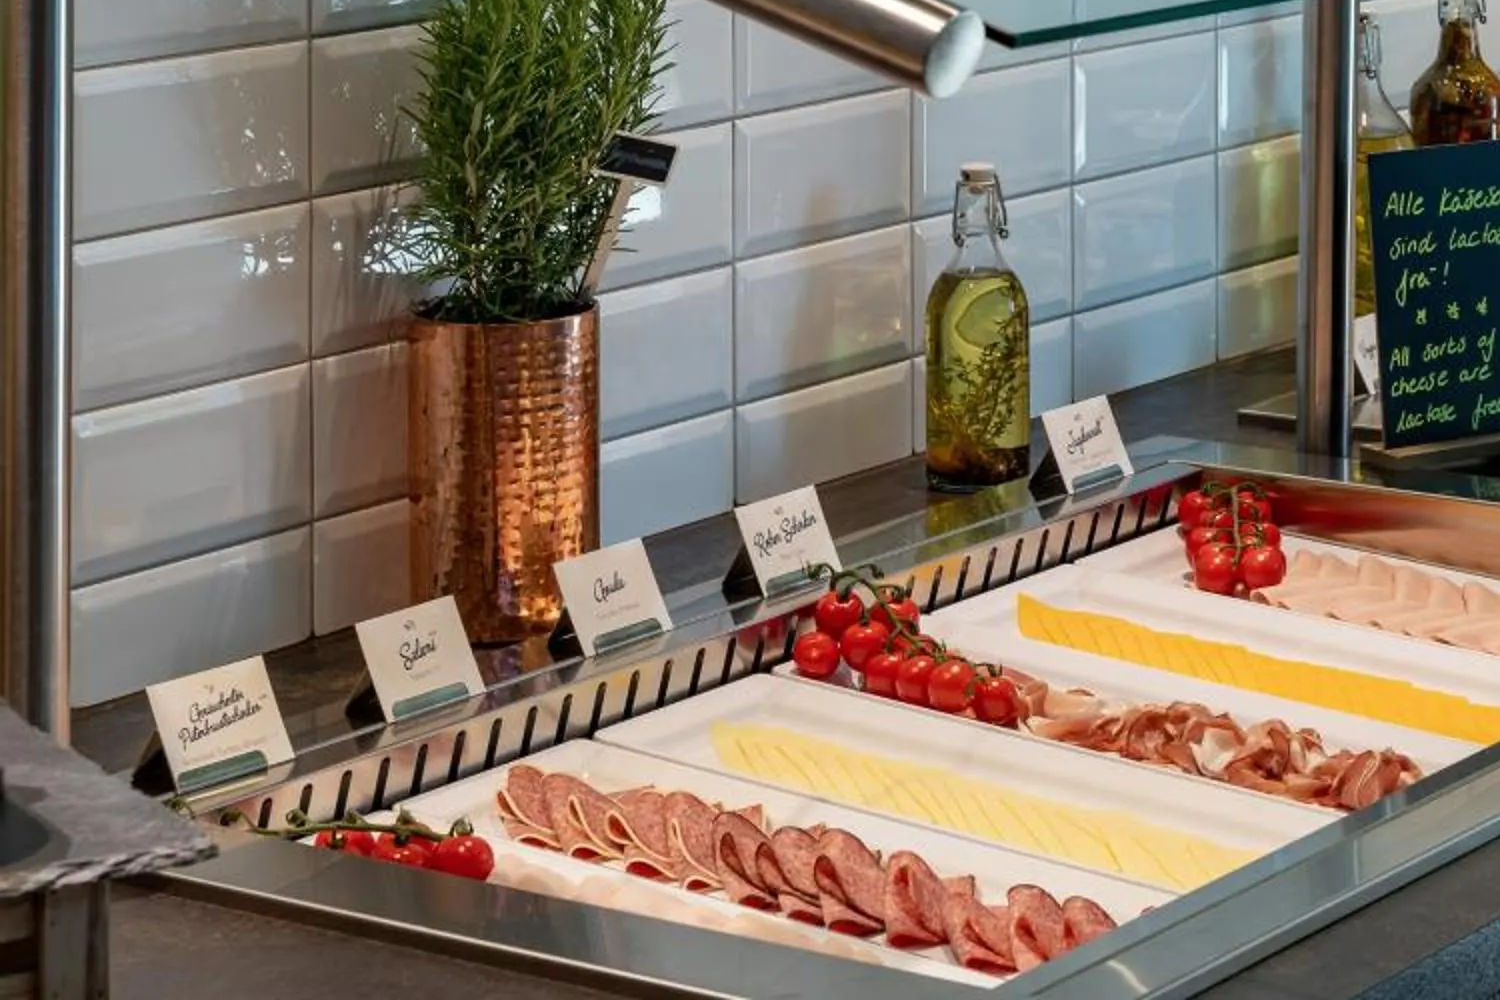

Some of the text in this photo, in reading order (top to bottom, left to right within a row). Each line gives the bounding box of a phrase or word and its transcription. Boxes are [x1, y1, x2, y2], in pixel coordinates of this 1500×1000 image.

[1385, 191, 1425, 217] Alle
[1389, 345, 1410, 372] All
[1423, 336, 1466, 362] sorts
[1477, 327, 1496, 362] of
[1391, 363, 1493, 397] cheese are
[1395, 402, 1457, 433] lactose
[780, 509, 817, 544] Schinken
[593, 570, 626, 602] Gouda
[399, 637, 437, 671] Salami
